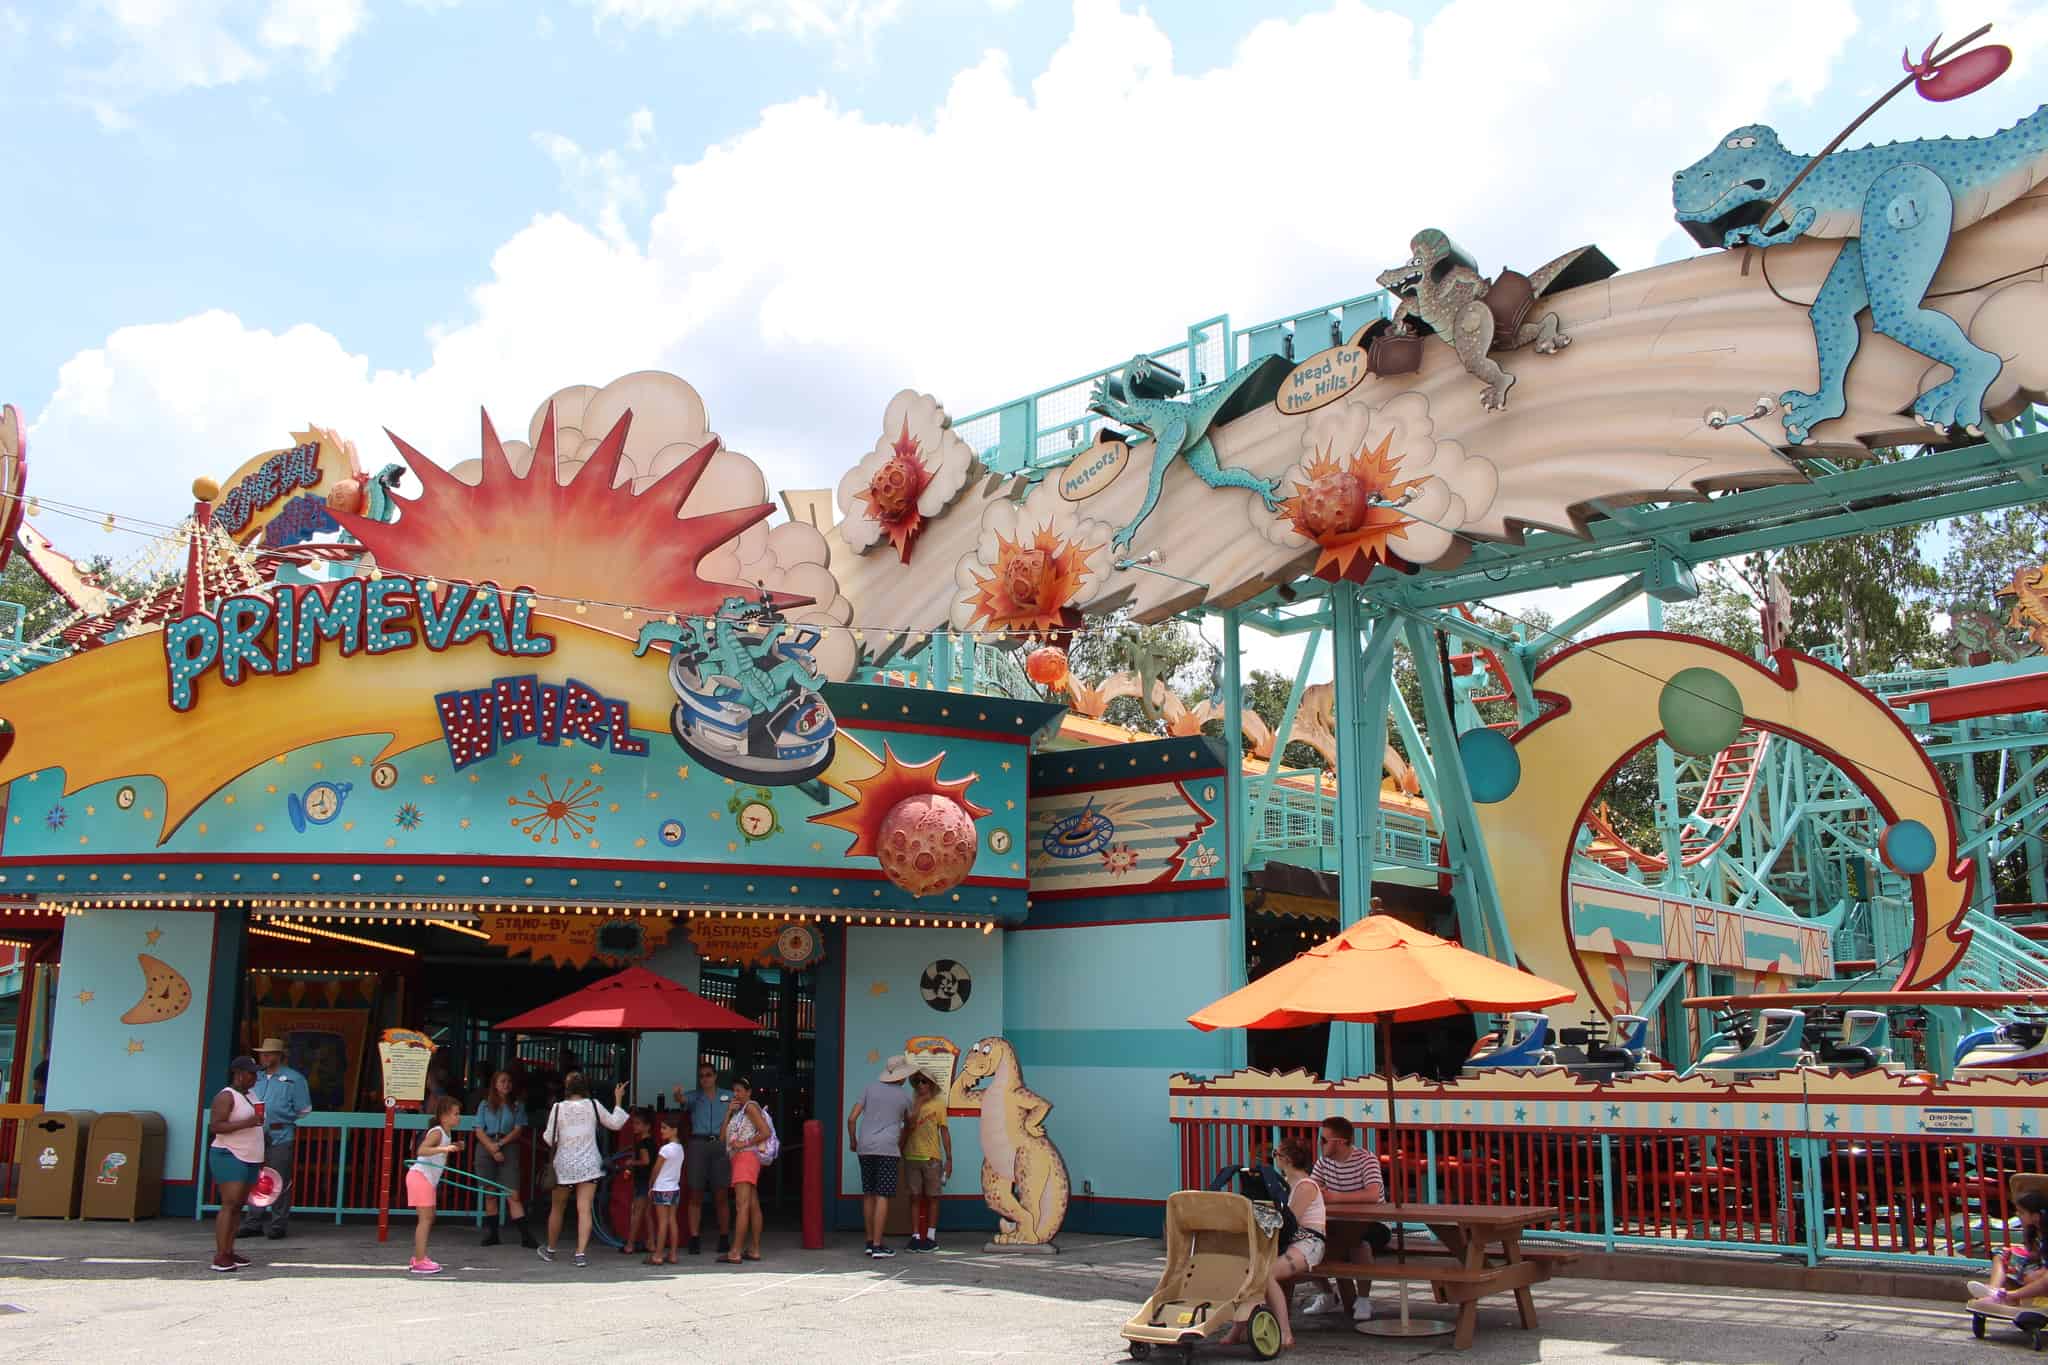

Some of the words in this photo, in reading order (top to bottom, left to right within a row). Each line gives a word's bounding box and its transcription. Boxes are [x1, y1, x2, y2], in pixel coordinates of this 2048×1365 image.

[1294, 358, 1332, 387] Head
[1336, 351, 1360, 366] for
[1287, 392, 1312, 409] the
[1065, 443, 1119, 494] Meteors!
[165, 577, 556, 711] PRIMEVAL
[435, 675, 649, 770] WHIRL
[496, 917, 570, 933] STAND-BY
